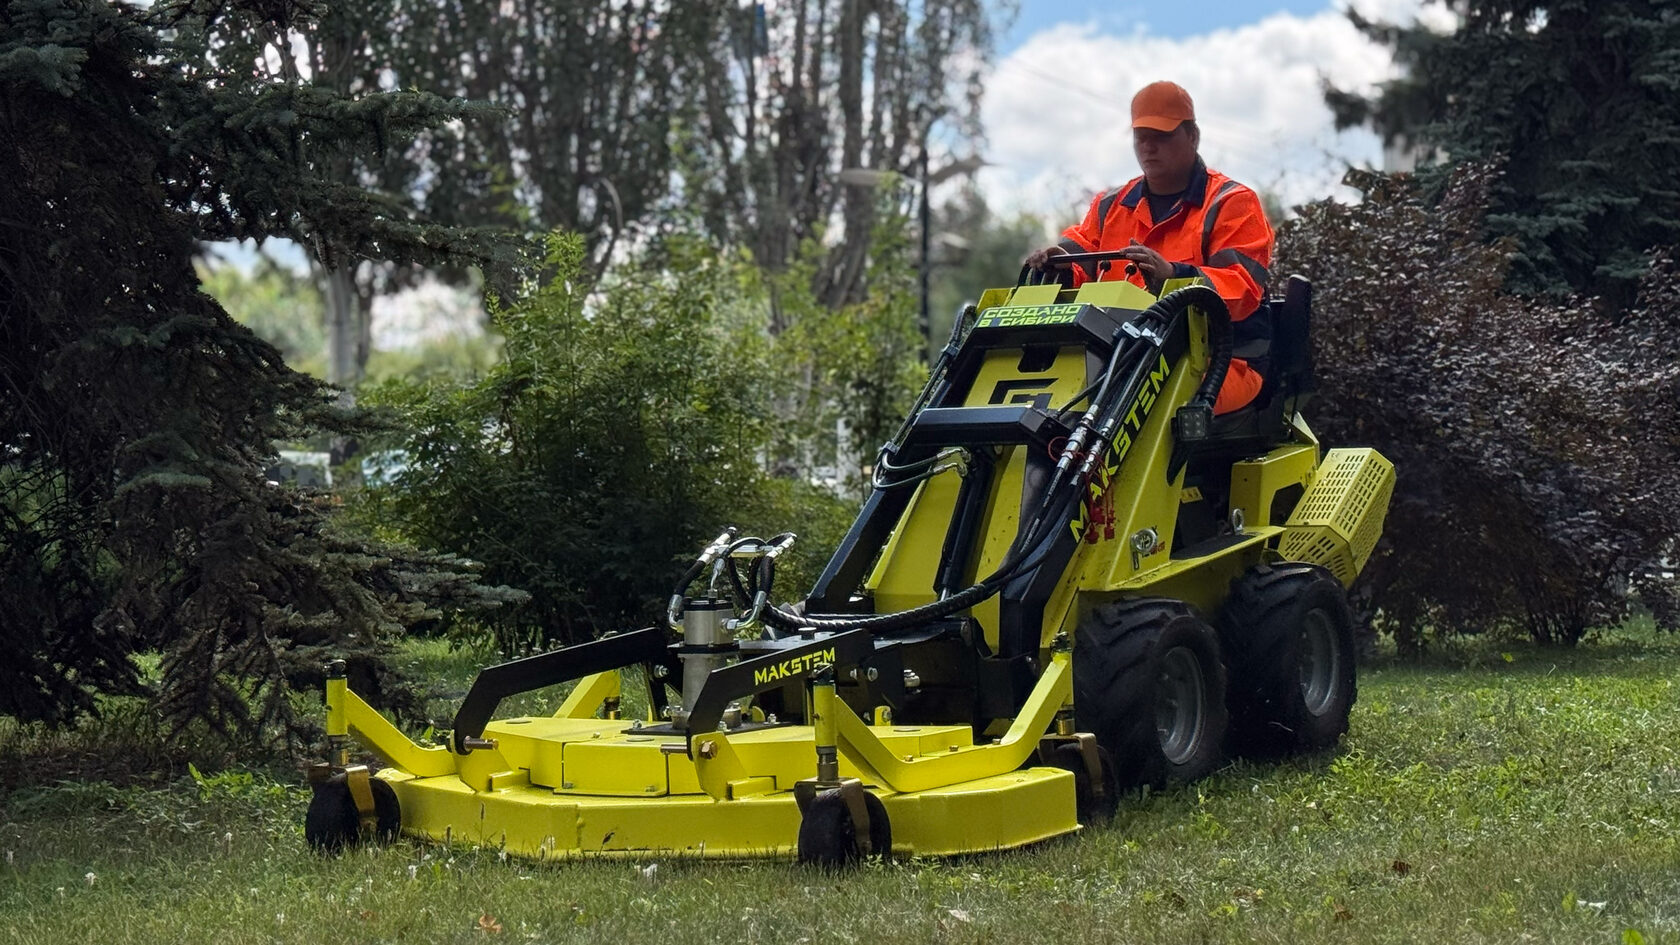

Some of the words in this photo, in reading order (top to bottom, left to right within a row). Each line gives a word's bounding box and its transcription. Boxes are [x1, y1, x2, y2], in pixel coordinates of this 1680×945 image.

[984, 305, 1082, 318] СОЗДАНО
[978, 319, 990, 328] В
[998, 314, 1077, 327] СИБИРИ
[754, 646, 836, 686] MAKSTEM
